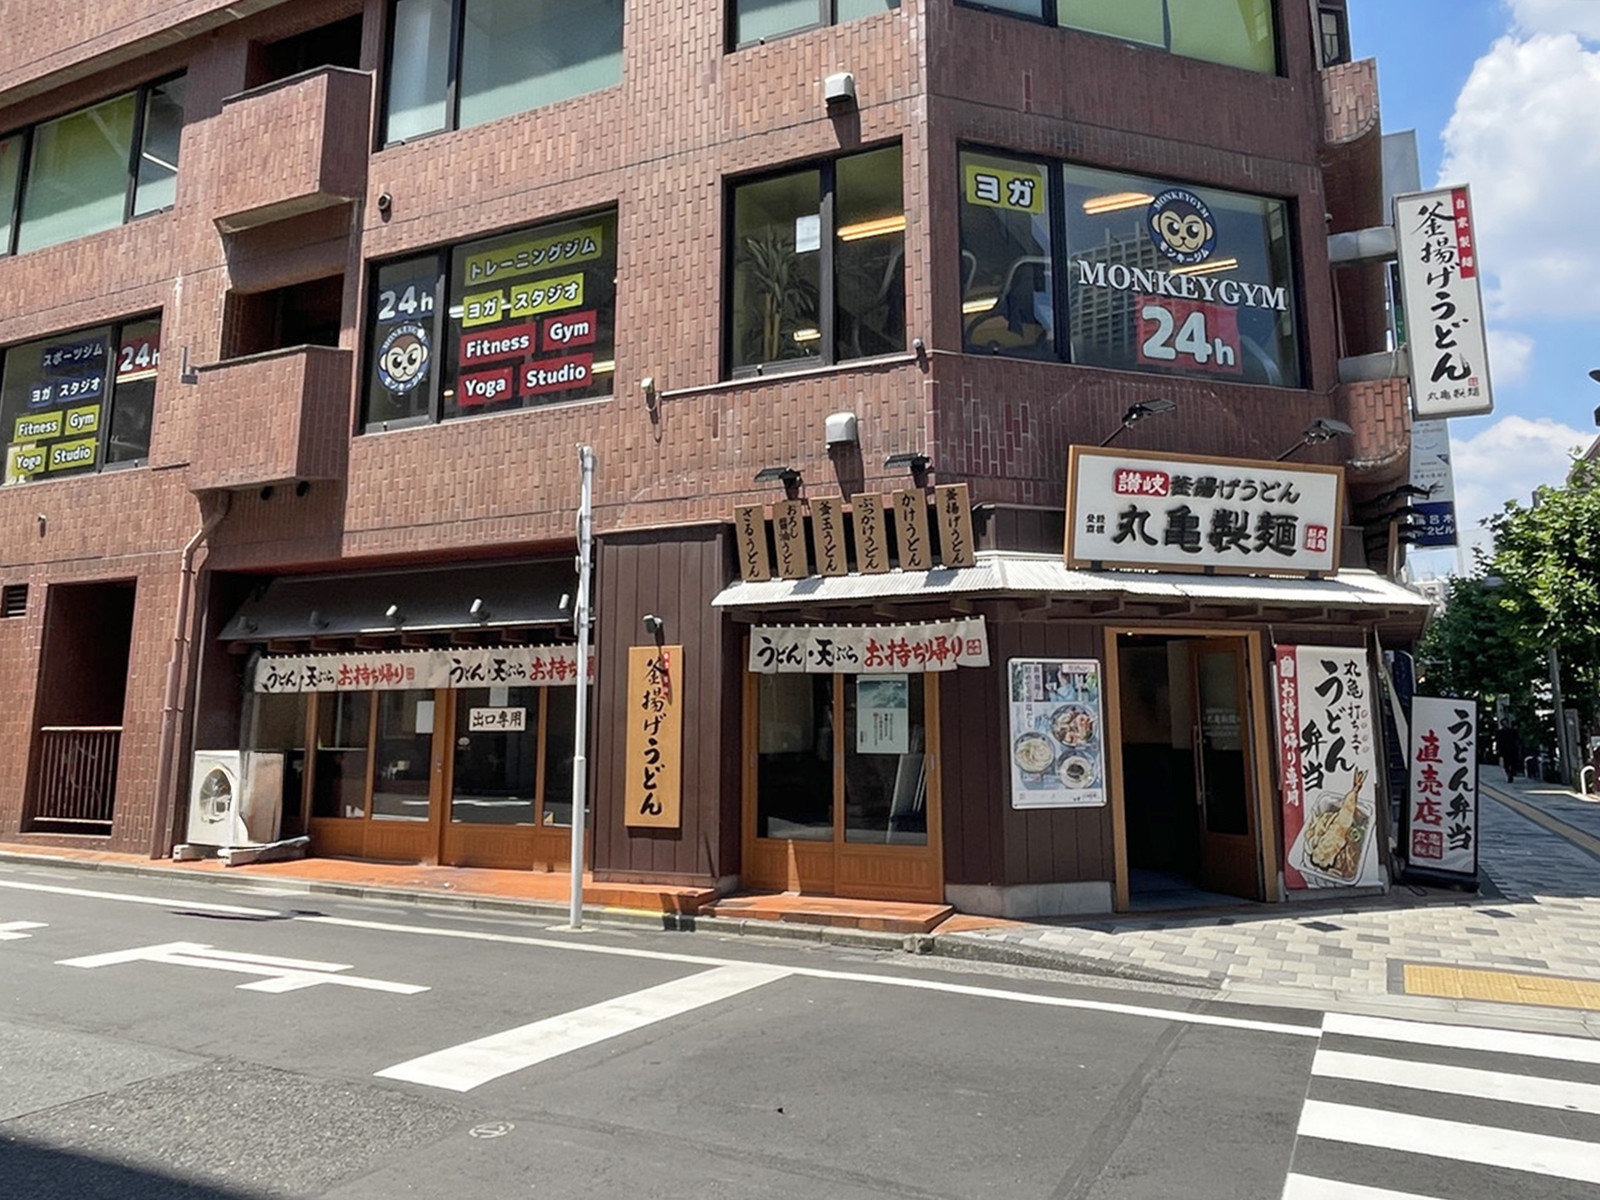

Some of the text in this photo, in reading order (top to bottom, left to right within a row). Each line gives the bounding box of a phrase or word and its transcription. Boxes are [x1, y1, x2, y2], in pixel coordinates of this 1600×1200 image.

[975, 175, 1034, 207] ヨガ
[1153, 191, 1209, 218] MONKEYGYM
[471, 238, 596, 279] トレーニングジム
[379, 286, 433, 320] 24h
[468, 283, 578, 319] ヨガ スタジオ
[1078, 259, 1288, 311] MONKEYGYM
[1411, 201, 1471, 382] 釜揚げうどん
[43, 343, 102, 366] スポーツジム
[466, 322, 589, 358] Fitness Gym
[1141, 305, 1235, 366] 24h
[32, 377, 100, 402] ヨガ スタジオ
[465, 364, 586, 398] Yoga Studio
[18, 413, 94, 436] Fitness Gym
[15, 446, 91, 469] Yoga Studio
[1117, 471, 1300, 504] 讃岐 釜揚げうどん
[787, 505, 798, 538] おろし
[819, 501, 838, 573] 釜玉うどん
[858, 498, 880, 570] ぶっかけうどん
[901, 493, 921, 567] かけうどん
[1113, 504, 1298, 556] 丸亀製麺
[864, 636, 963, 668] お持ち帰り
[338, 662, 404, 686] お持ち帰り
[1343, 659, 1363, 699] 丸亀
[472, 710, 522, 728] 出口専用
[1315, 659, 1355, 773] うどん
[641, 657, 668, 816] 釜揚げうどん
[1280, 679, 1300, 807] お持ち帰り専用
[1300, 719, 1327, 792] 弁当
[1413, 729, 1443, 826] 直売店
[1446, 709, 1473, 850] うどん弁当
